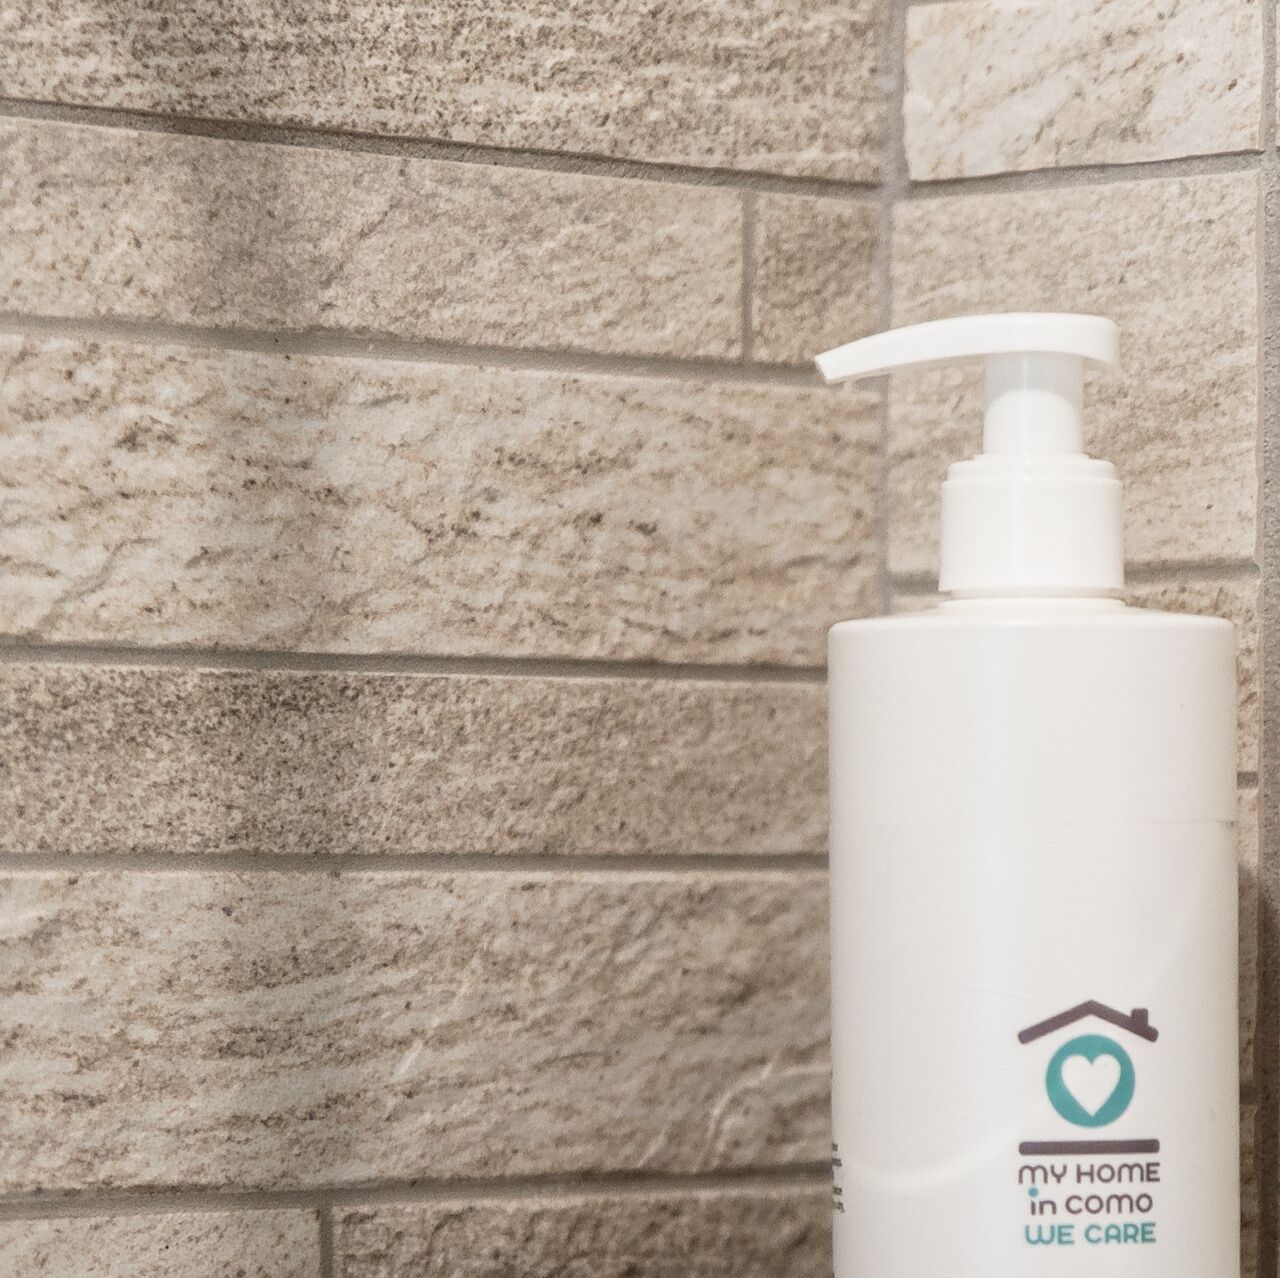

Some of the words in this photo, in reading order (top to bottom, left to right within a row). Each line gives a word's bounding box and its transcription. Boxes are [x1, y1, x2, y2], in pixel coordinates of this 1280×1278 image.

[1019, 1164, 1067, 1184] MY
[1077, 1162, 1160, 1183] HOME
[1028, 1186, 1056, 1215] in
[1025, 1224, 1074, 1245] WE
[1084, 1223, 1156, 1244] CARE
